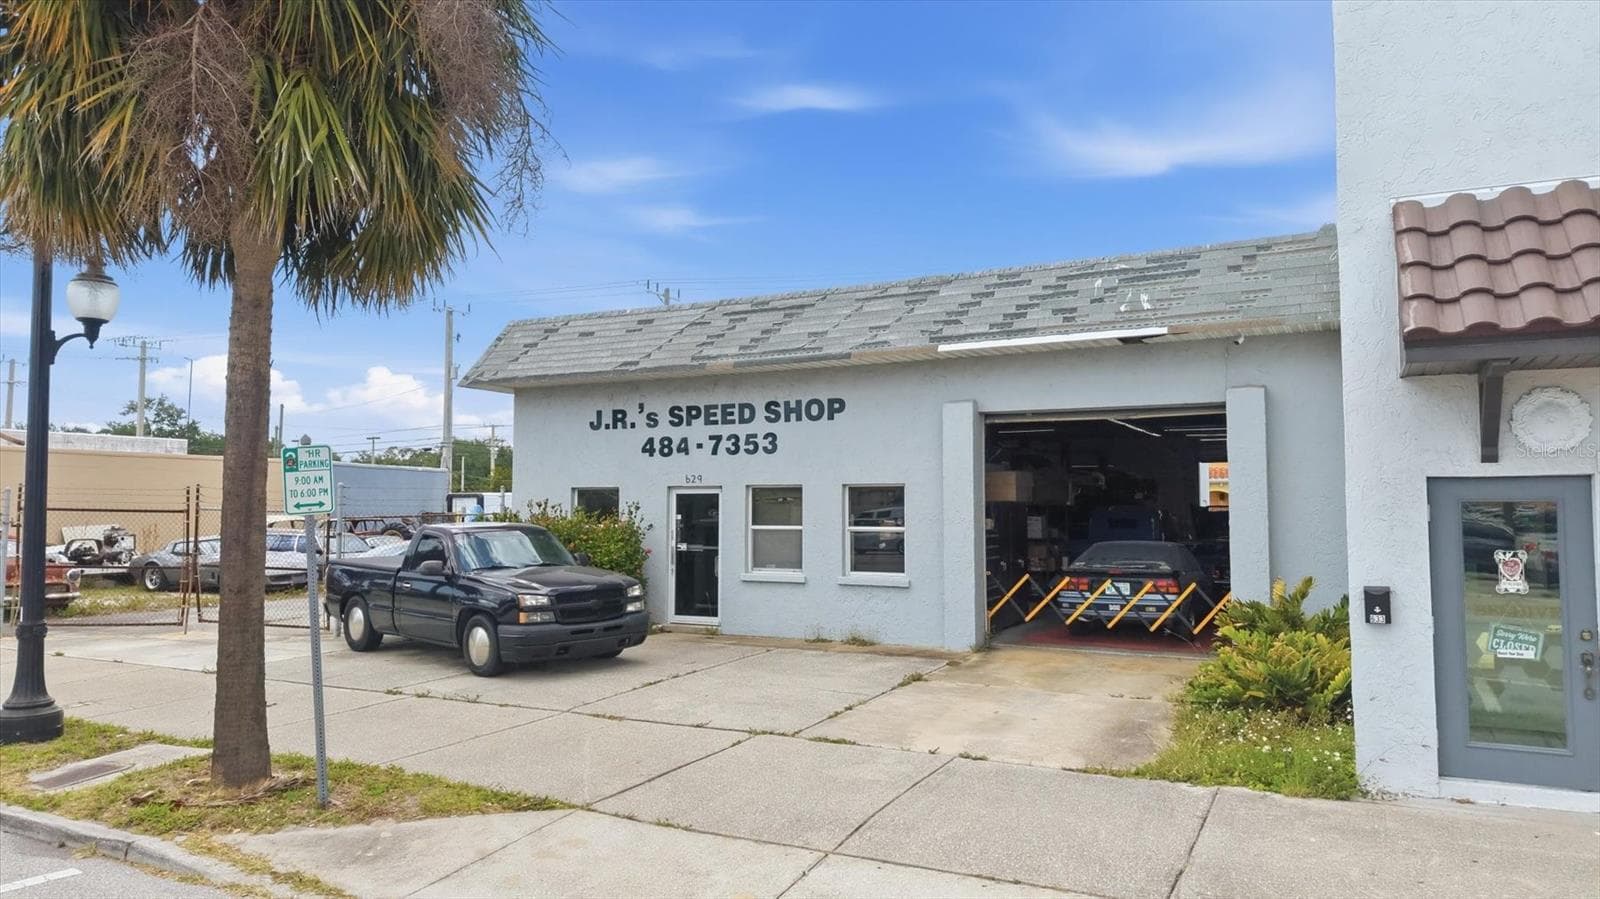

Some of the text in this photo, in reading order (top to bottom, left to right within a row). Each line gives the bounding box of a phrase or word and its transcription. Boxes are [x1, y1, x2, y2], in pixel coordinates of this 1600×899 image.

[589, 398, 846, 431] J.R.'s SPEED SHOP
[299, 459, 330, 469] PARKING
[294, 475, 324, 486] 9:00 AM
[685, 474, 703, 484] 629
[289, 488, 329, 499] TO 6:00 PM
[1492, 638, 1537, 652] CLOSED
